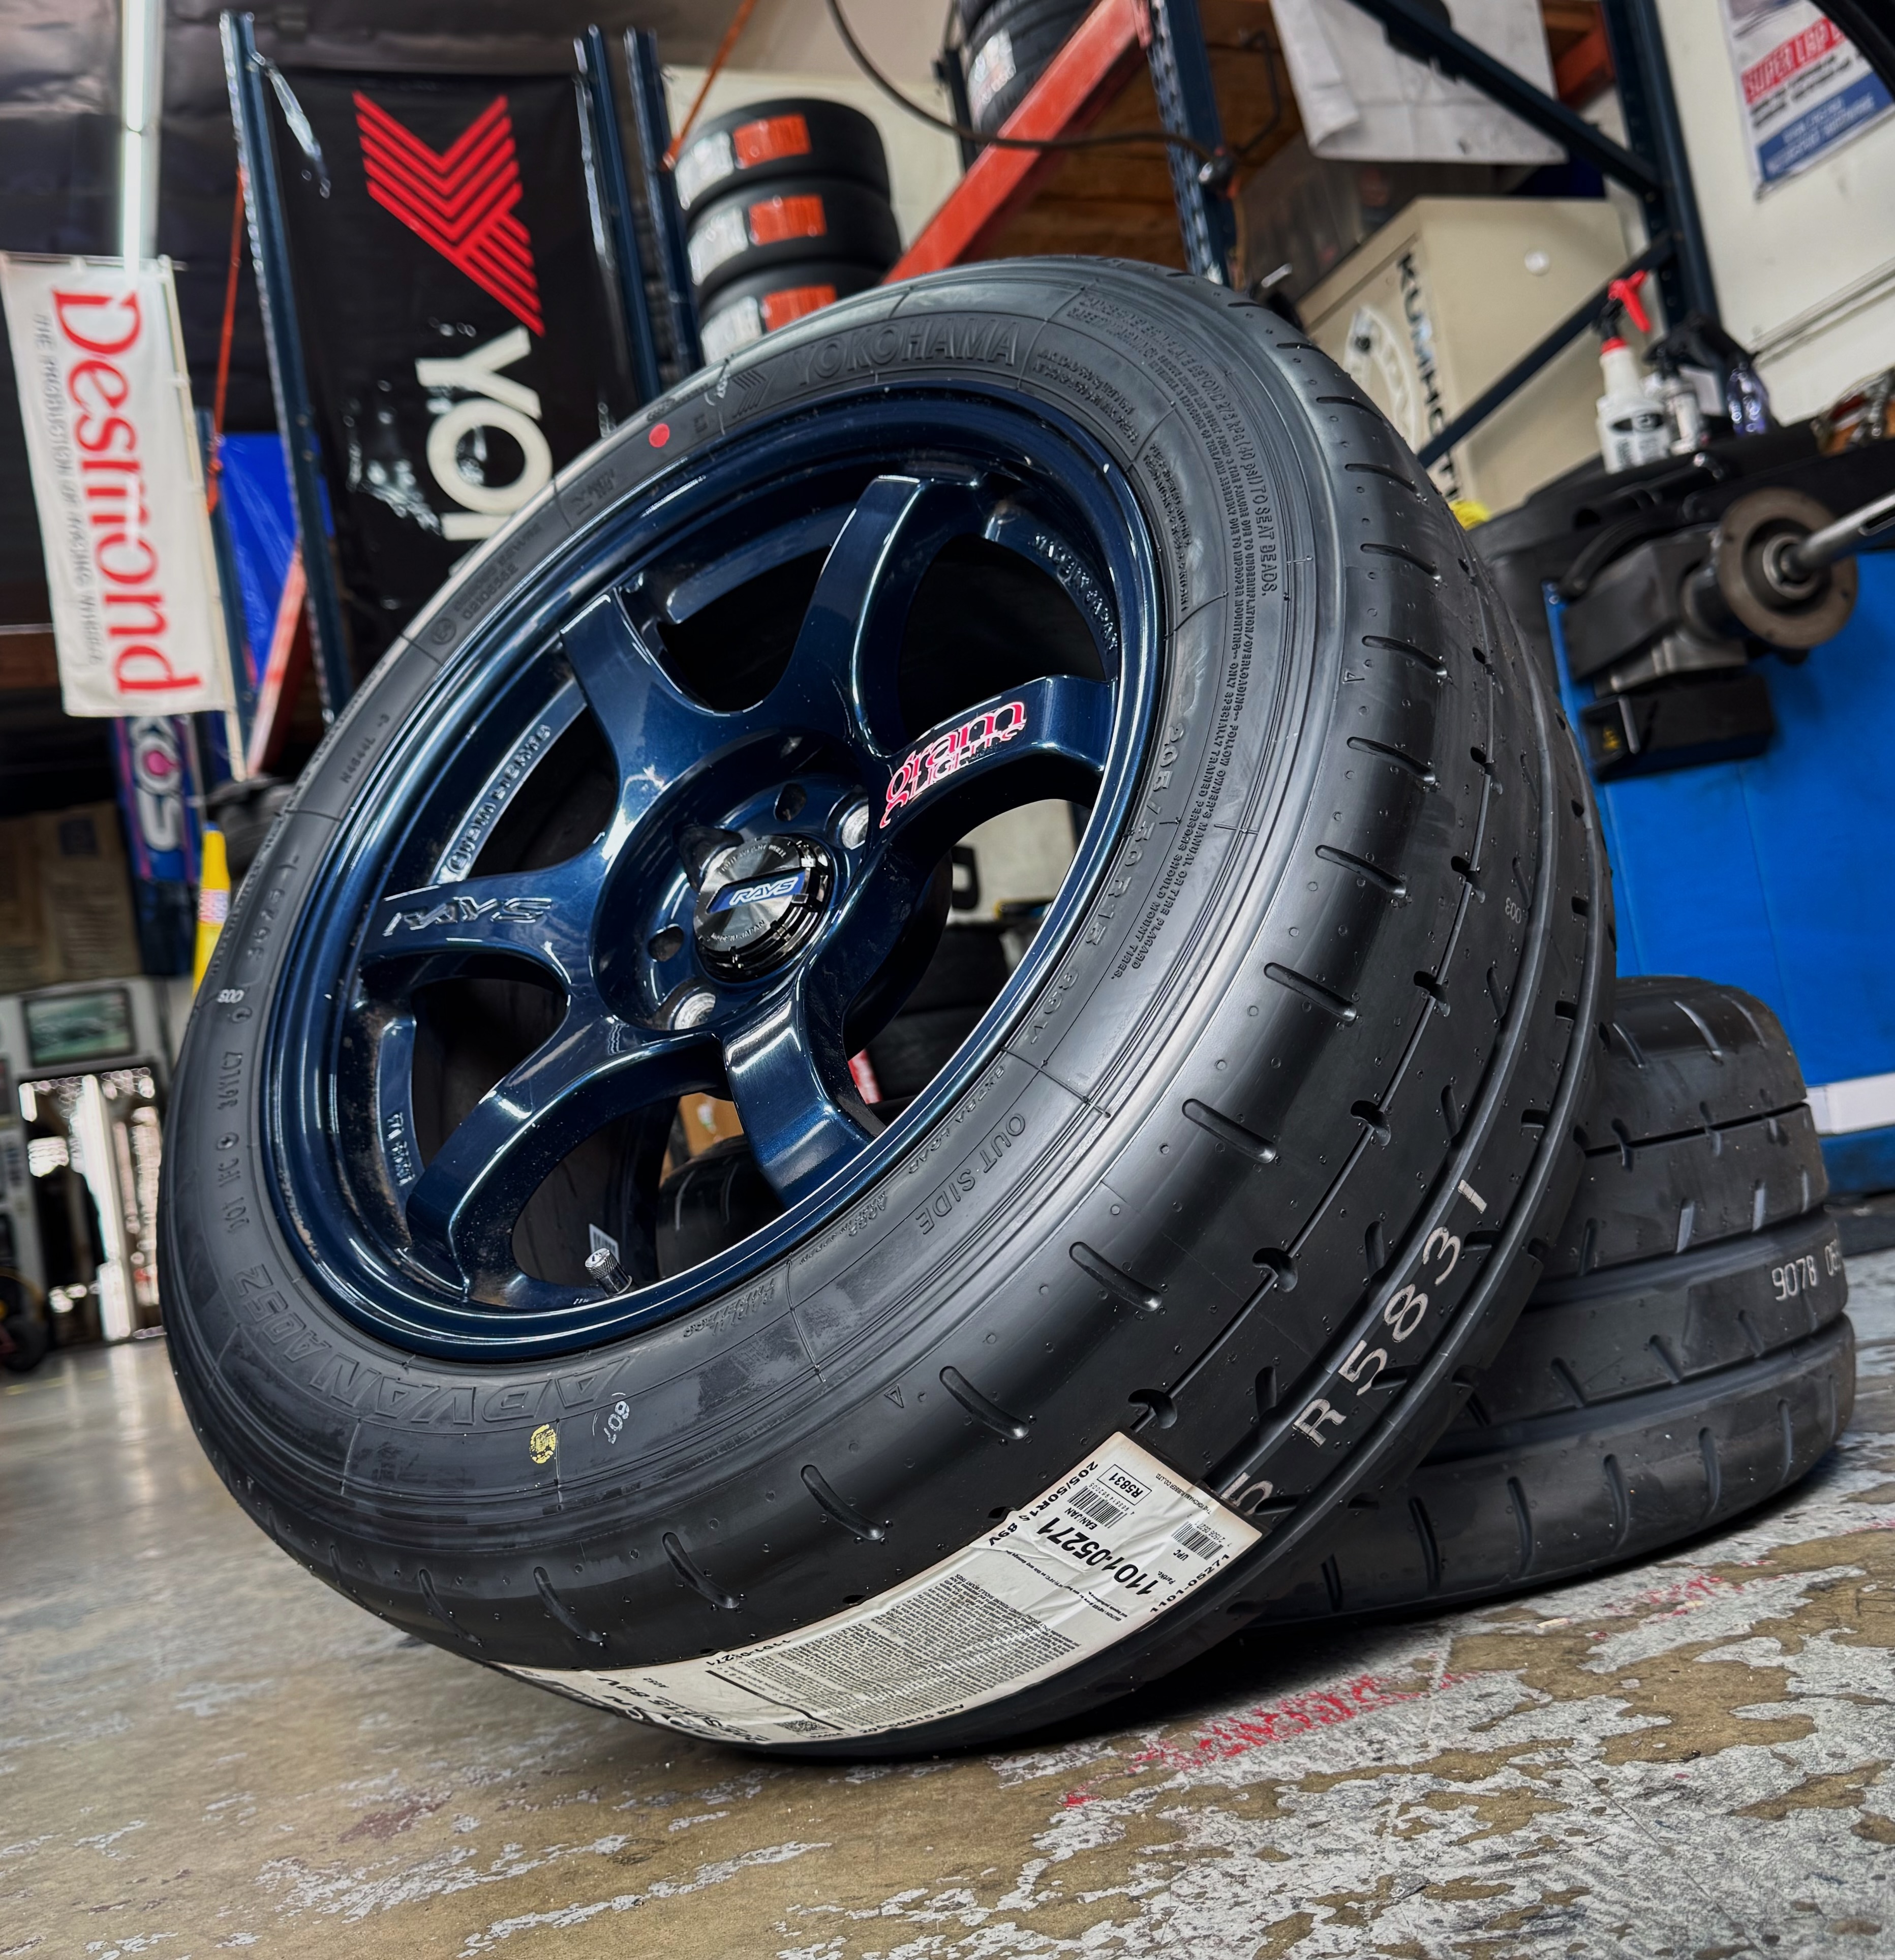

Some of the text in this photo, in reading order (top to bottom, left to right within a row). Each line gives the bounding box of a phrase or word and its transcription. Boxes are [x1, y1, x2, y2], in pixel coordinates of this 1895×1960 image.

[789, 320, 1017, 387] YOKOHAMA
[414, 324, 553, 541] YO
[51, 286, 205, 695] Desmond
[1248, 483, 1270, 507] TO
[1228, 516, 1242, 535] DUE
[1231, 534, 1244, 549] TO
[1239, 517, 1255, 537] DUE
[1242, 535, 1256, 551] TO
[1252, 503, 1275, 543] SEAT
[1232, 548, 1245, 598] IMPROPER
[1257, 541, 1279, 596] BEADS.
[1226, 661, 1240, 688] ONLY
[1213, 691, 1235, 746] SPECIALLY
[879, 701, 1027, 829] gram
[1218, 724, 1240, 767] FOLLOW
[1197, 749, 1221, 798] TRAINED
[1201, 770, 1228, 818] OWNER'S
[1177, 801, 1205, 852] PERSONS
[1181, 821, 1209, 868] MANUAL
[728, 876, 800, 907] RAYS
[1155, 853, 1184, 900] SHOULD
[1172, 869, 1189, 889] OR
[382, 896, 553, 937] RAYS
[1133, 901, 1162, 943] MOUNT
[1158, 887, 1181, 916] TIRE
[1110, 943, 1139, 983] TIRES.
[912, 1109, 1031, 1237] OUT SIDE
[1771, 1254, 1818, 1302] 9078
[1291, 1179, 1487, 1448] R5831
[233, 1263, 631, 1426] ADVAN A052
[986, 1457, 1099, 1549] 205/50R15 89V
[1108, 1470, 1144, 1500] R5831
[1064, 1505, 1098, 1532] EAN/JAN
[1035, 1508, 1159, 1605] 1101-05271
[1172, 1547, 1189, 1563] UPC
[1148, 1552, 1231, 1615] 1101-05271
